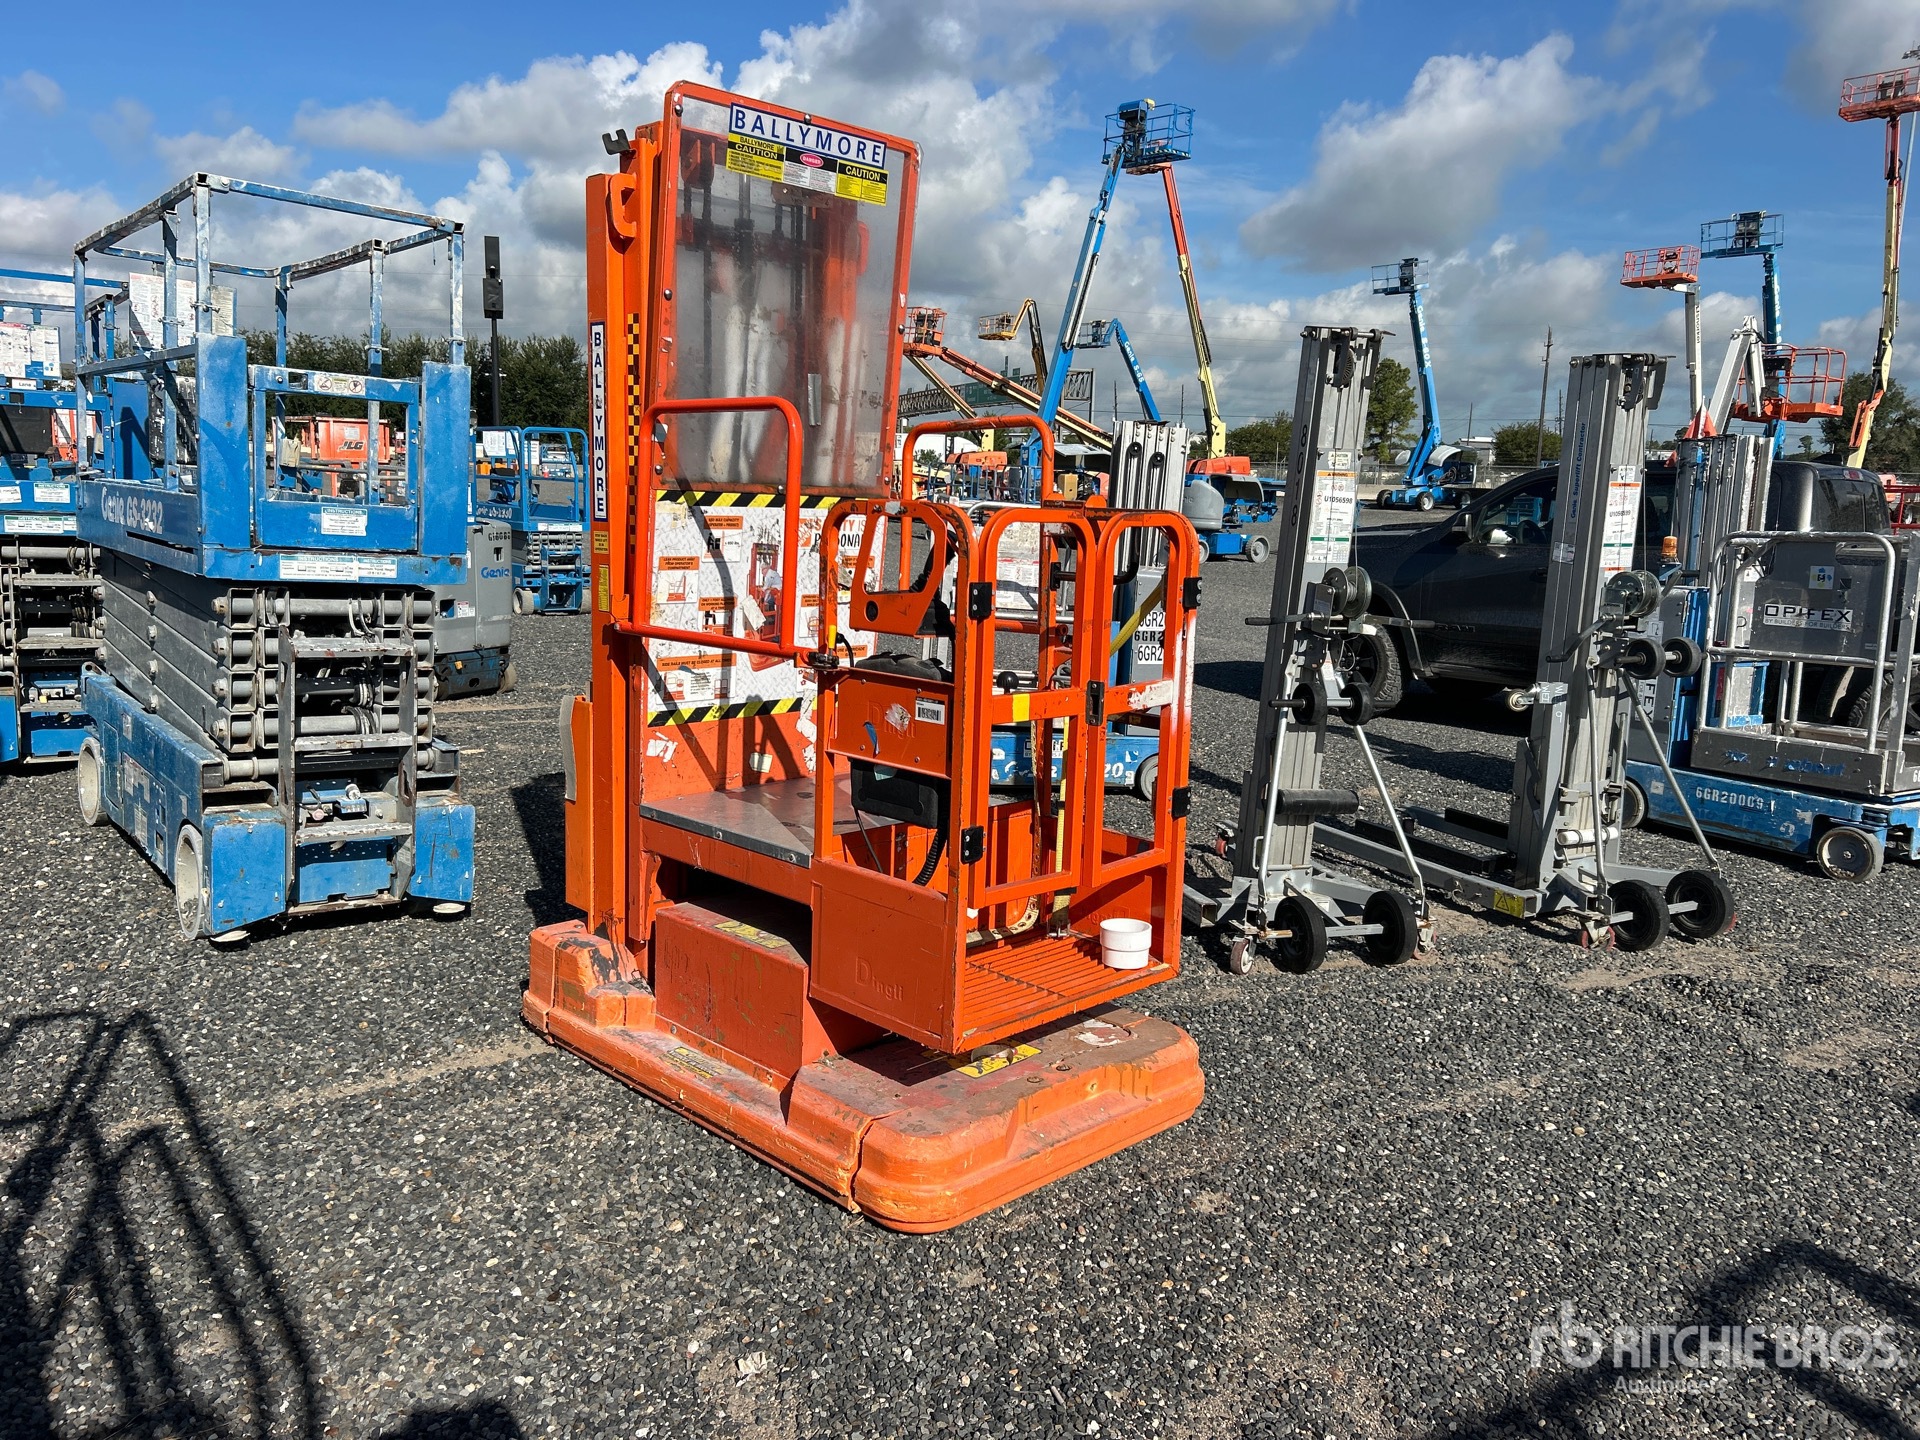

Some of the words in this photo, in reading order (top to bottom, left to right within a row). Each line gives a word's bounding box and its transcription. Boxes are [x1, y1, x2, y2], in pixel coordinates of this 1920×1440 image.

[734, 109, 881, 164] BALLYMORE
[739, 136, 775, 151] BALLYMORE
[735, 143, 778, 160] CAUTION
[845, 165, 881, 182] CAUTION
[594, 330, 605, 512] BALLYMORE
[338, 441, 364, 450] JLG
[1576, 422, 1586, 462] Contractor
[102, 486, 126, 525] Genie
[481, 566, 510, 579] Genie
[1764, 604, 1850, 622] OPIFEX
[1138, 646, 1162, 662] 6GR2
